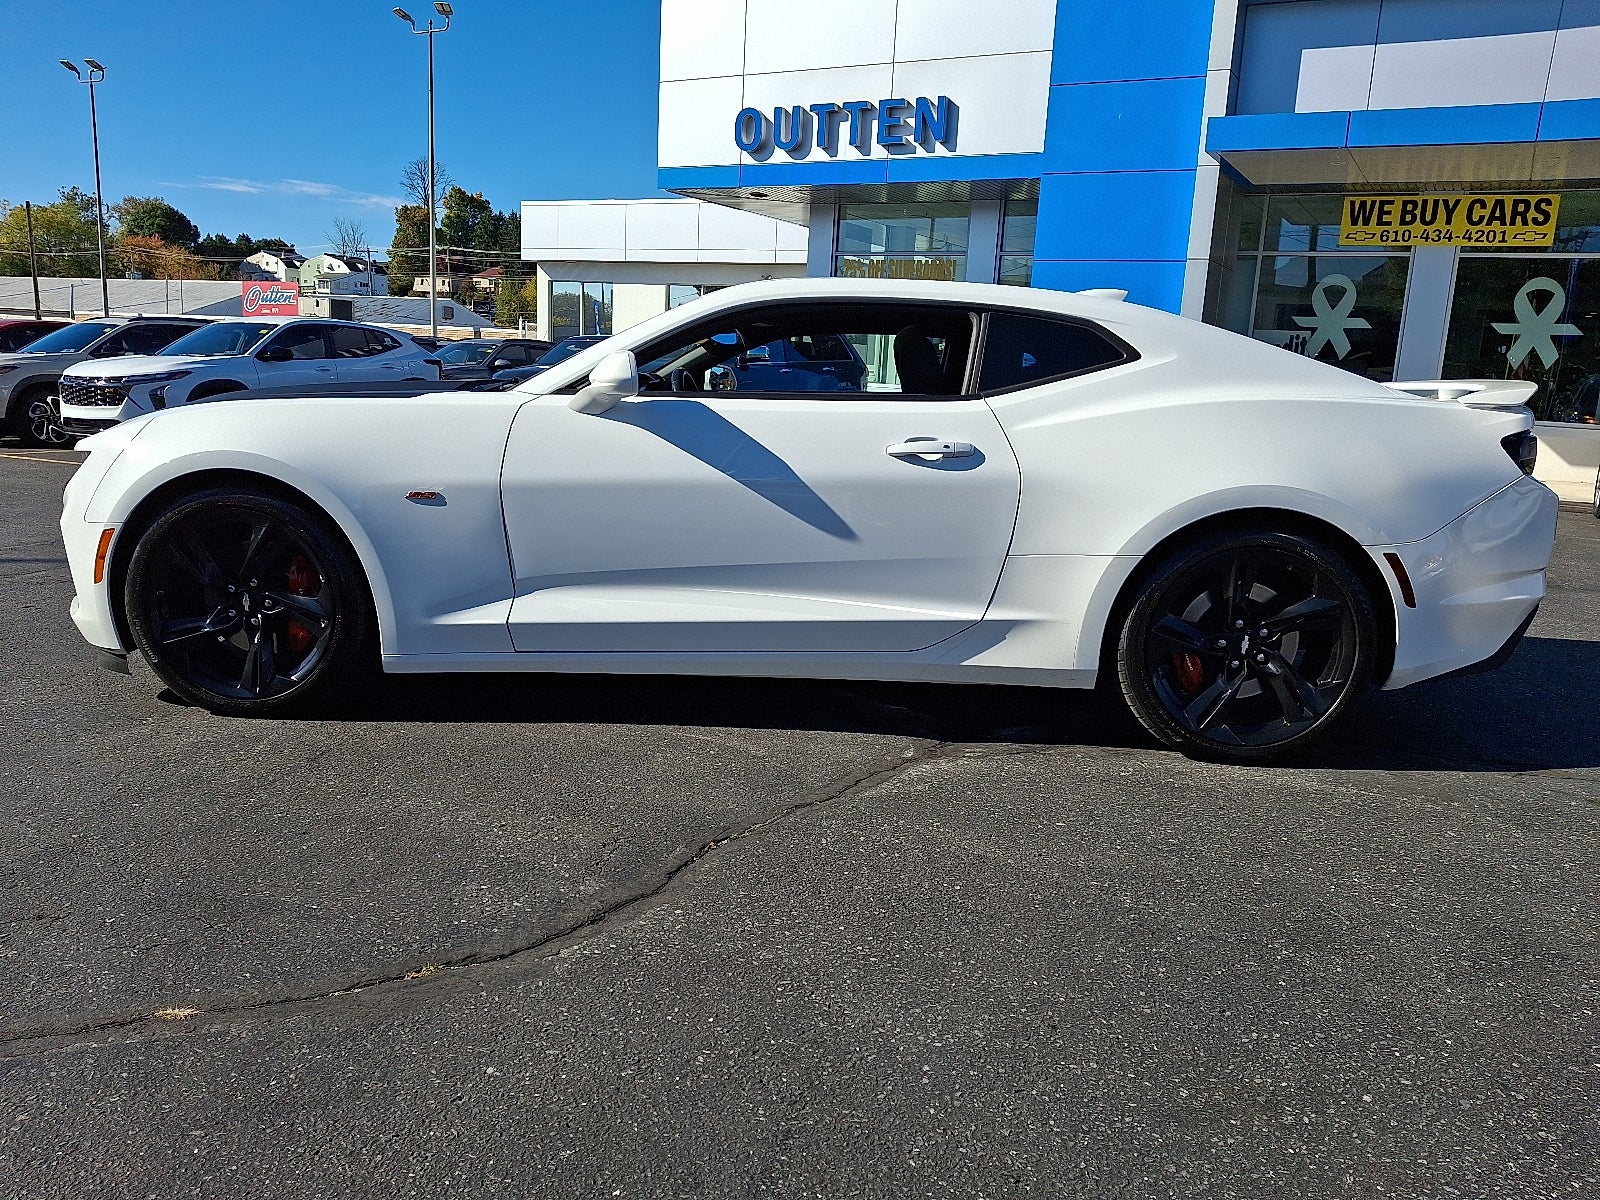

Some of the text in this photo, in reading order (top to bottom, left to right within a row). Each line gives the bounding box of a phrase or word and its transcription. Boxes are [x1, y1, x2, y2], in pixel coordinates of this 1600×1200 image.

[735, 96, 948, 152] OUTTEN
[1349, 197, 1553, 227] WE BUY CARS
[1379, 228, 1508, 244] 610-434-4201
[244, 286, 297, 312] Outten
